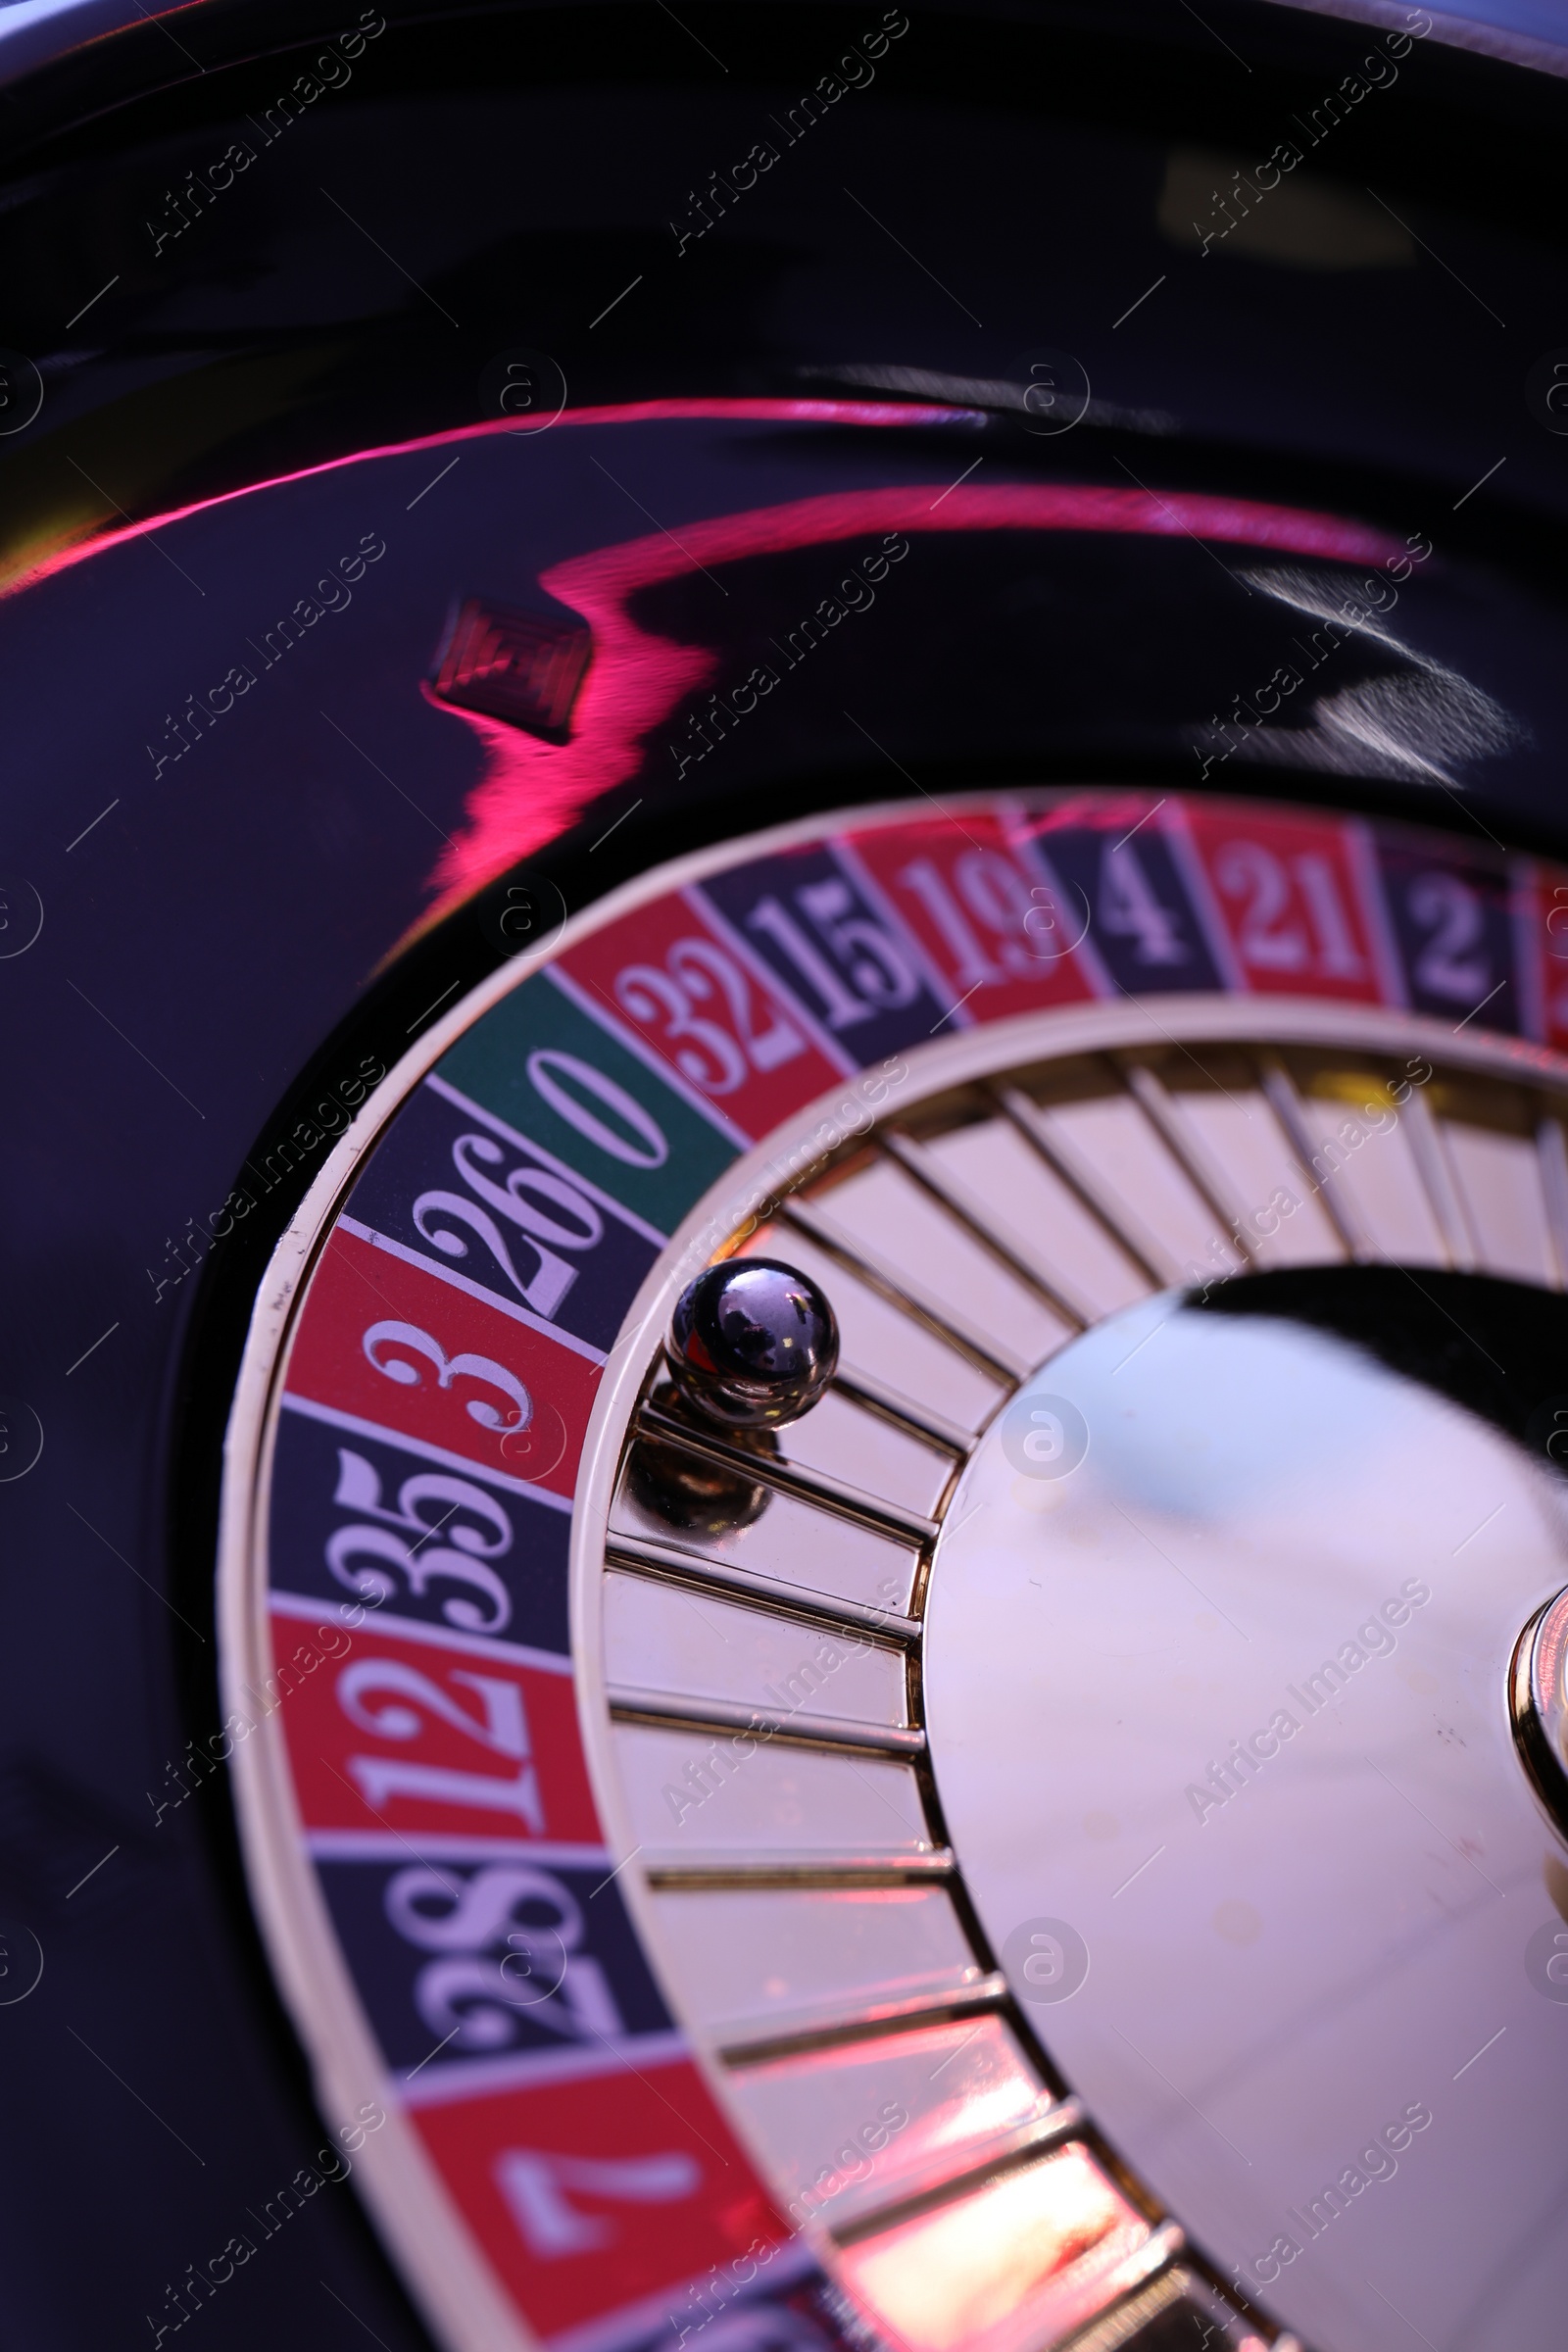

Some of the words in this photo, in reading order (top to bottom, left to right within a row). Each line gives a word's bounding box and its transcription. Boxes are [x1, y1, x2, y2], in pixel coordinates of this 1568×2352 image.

[745, 879, 919, 1029] 15
[897, 846, 1062, 988] 19
[1096, 836, 1191, 965] 4
[1218, 841, 1367, 975] 21
[1406, 870, 1492, 1004] 2
[613, 936, 807, 1096] 32
[527, 1049, 667, 1169] 0
[413, 1134, 604, 1320] 26
[363, 1320, 532, 1433] 3
[324, 1447, 514, 1635] 35
[338, 1658, 545, 1836] 12
[384, 1866, 625, 2050] 28
[490, 2146, 701, 2261] 7
